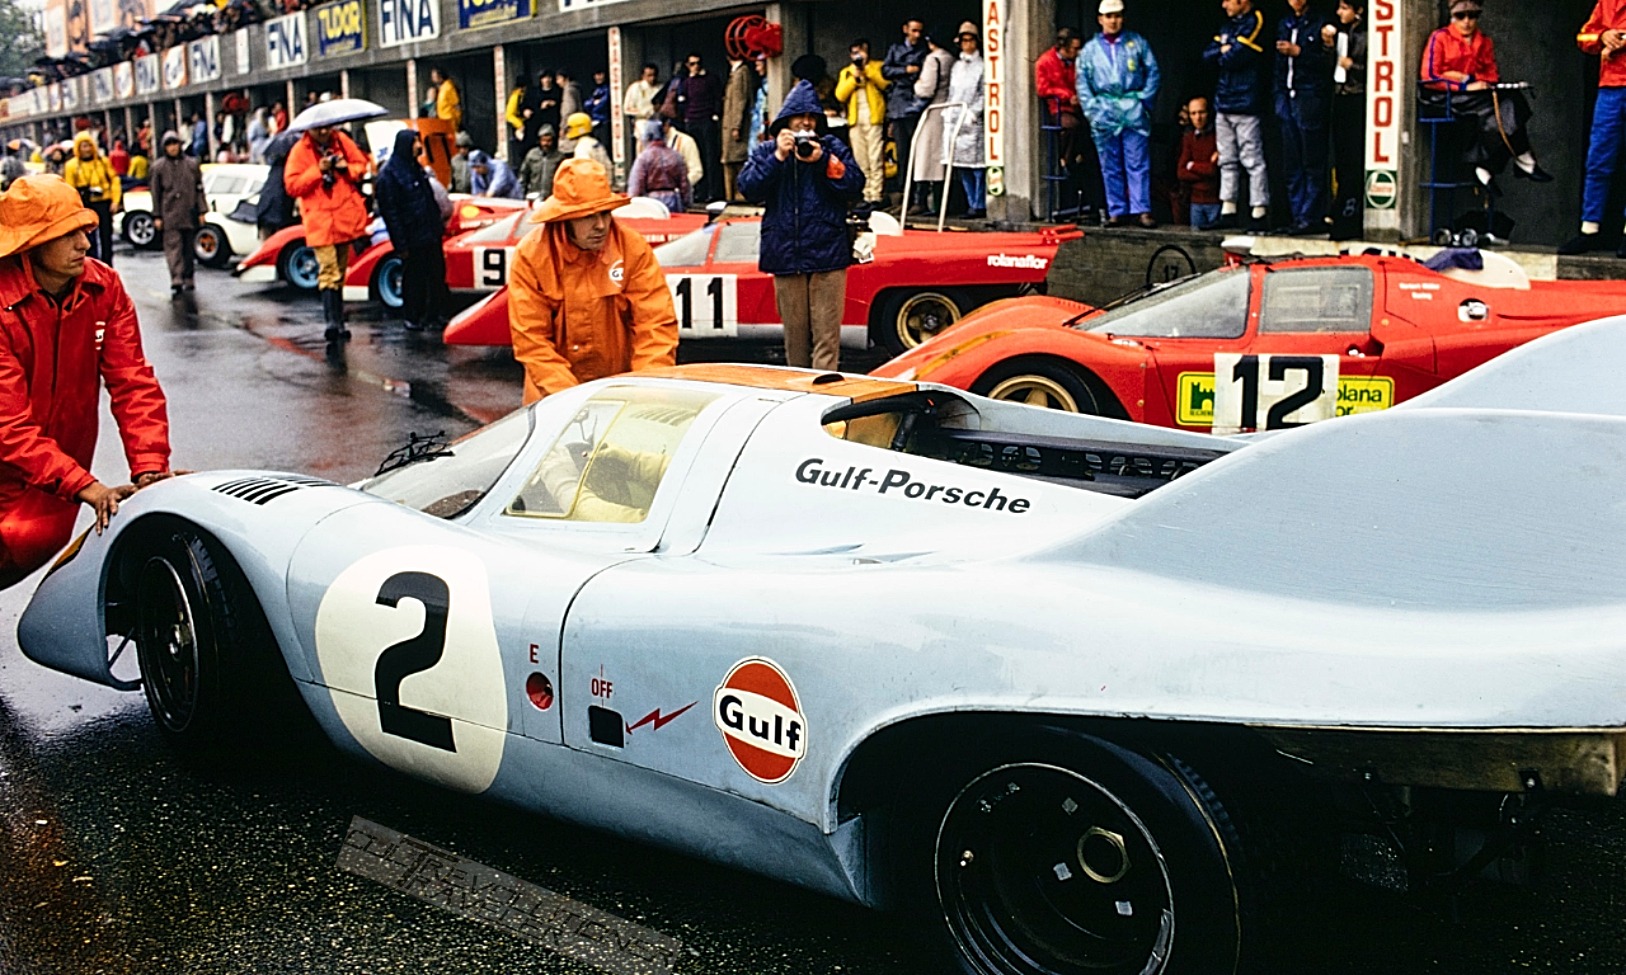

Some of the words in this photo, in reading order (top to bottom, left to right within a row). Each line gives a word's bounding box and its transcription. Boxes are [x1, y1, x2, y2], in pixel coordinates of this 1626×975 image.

[268, 15, 305, 64] FINA
[318, 1, 362, 40] TUDOR
[382, 0, 435, 43] FINA
[987, 2, 1000, 161] ASTROL
[1373, 0, 1394, 163] STROL
[483, 248, 506, 286] 9
[675, 277, 724, 330] 11
[1232, 354, 1324, 431] 12
[795, 458, 1031, 514] Gulf-Porsche
[374, 571, 457, 753] 2
[529, 643, 540, 664] E
[591, 678, 613, 699] OFF
[719, 694, 801, 752] Gulf
